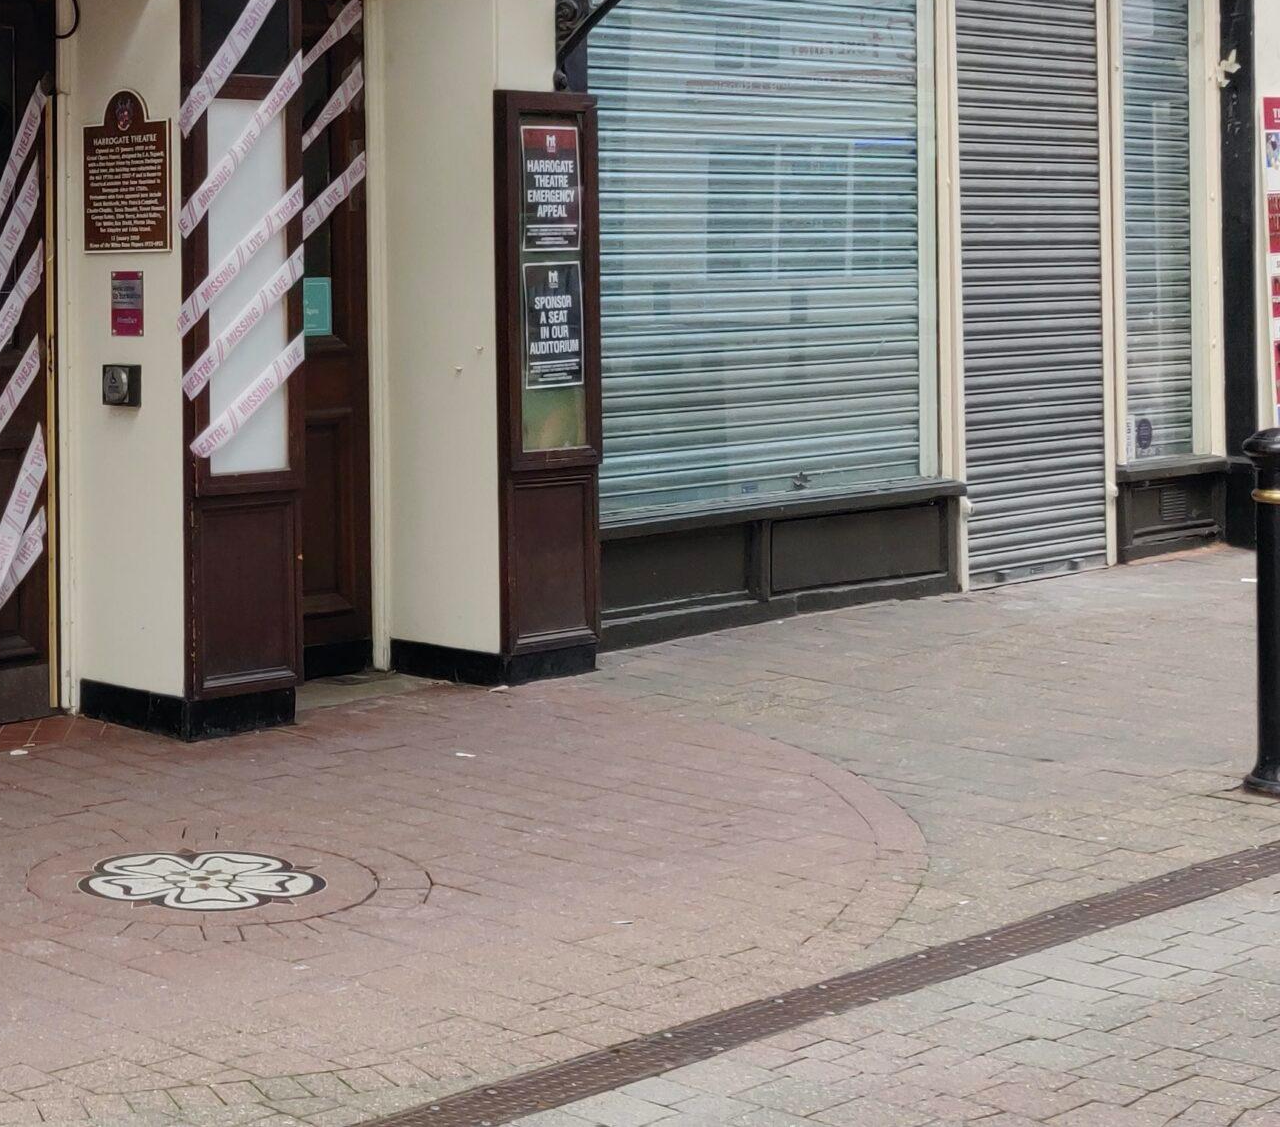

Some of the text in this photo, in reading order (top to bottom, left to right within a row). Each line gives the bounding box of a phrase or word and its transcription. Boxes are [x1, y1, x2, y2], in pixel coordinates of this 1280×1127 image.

[213, 52, 233, 83] LIVE
[15, 109, 39, 159] THEATRE
[93, 133, 157, 145] HARROGATE THEATRE
[198, 77, 297, 209] MISSING LIVE THEATRE
[527, 160, 574, 173] HARROGATE
[534, 175, 568, 187] THEATRE
[325, 187, 342, 210] LIVE
[527, 189, 575, 203] EMERGENCY
[537, 205, 568, 217] APPEAL
[3, 224, 22, 252] LIVE
[201, 230, 266, 303] MISSING LIVE
[226, 275, 289, 348] MISSING LIVE
[535, 295, 572, 309] SPONSOR
[540, 310, 568, 324] A SEAT
[540, 325, 569, 339] IN OUR
[530, 339, 579, 355] AUDITORIUM
[238, 345, 302, 416] MISSING LIVE
[14, 487, 33, 515] LIVE
